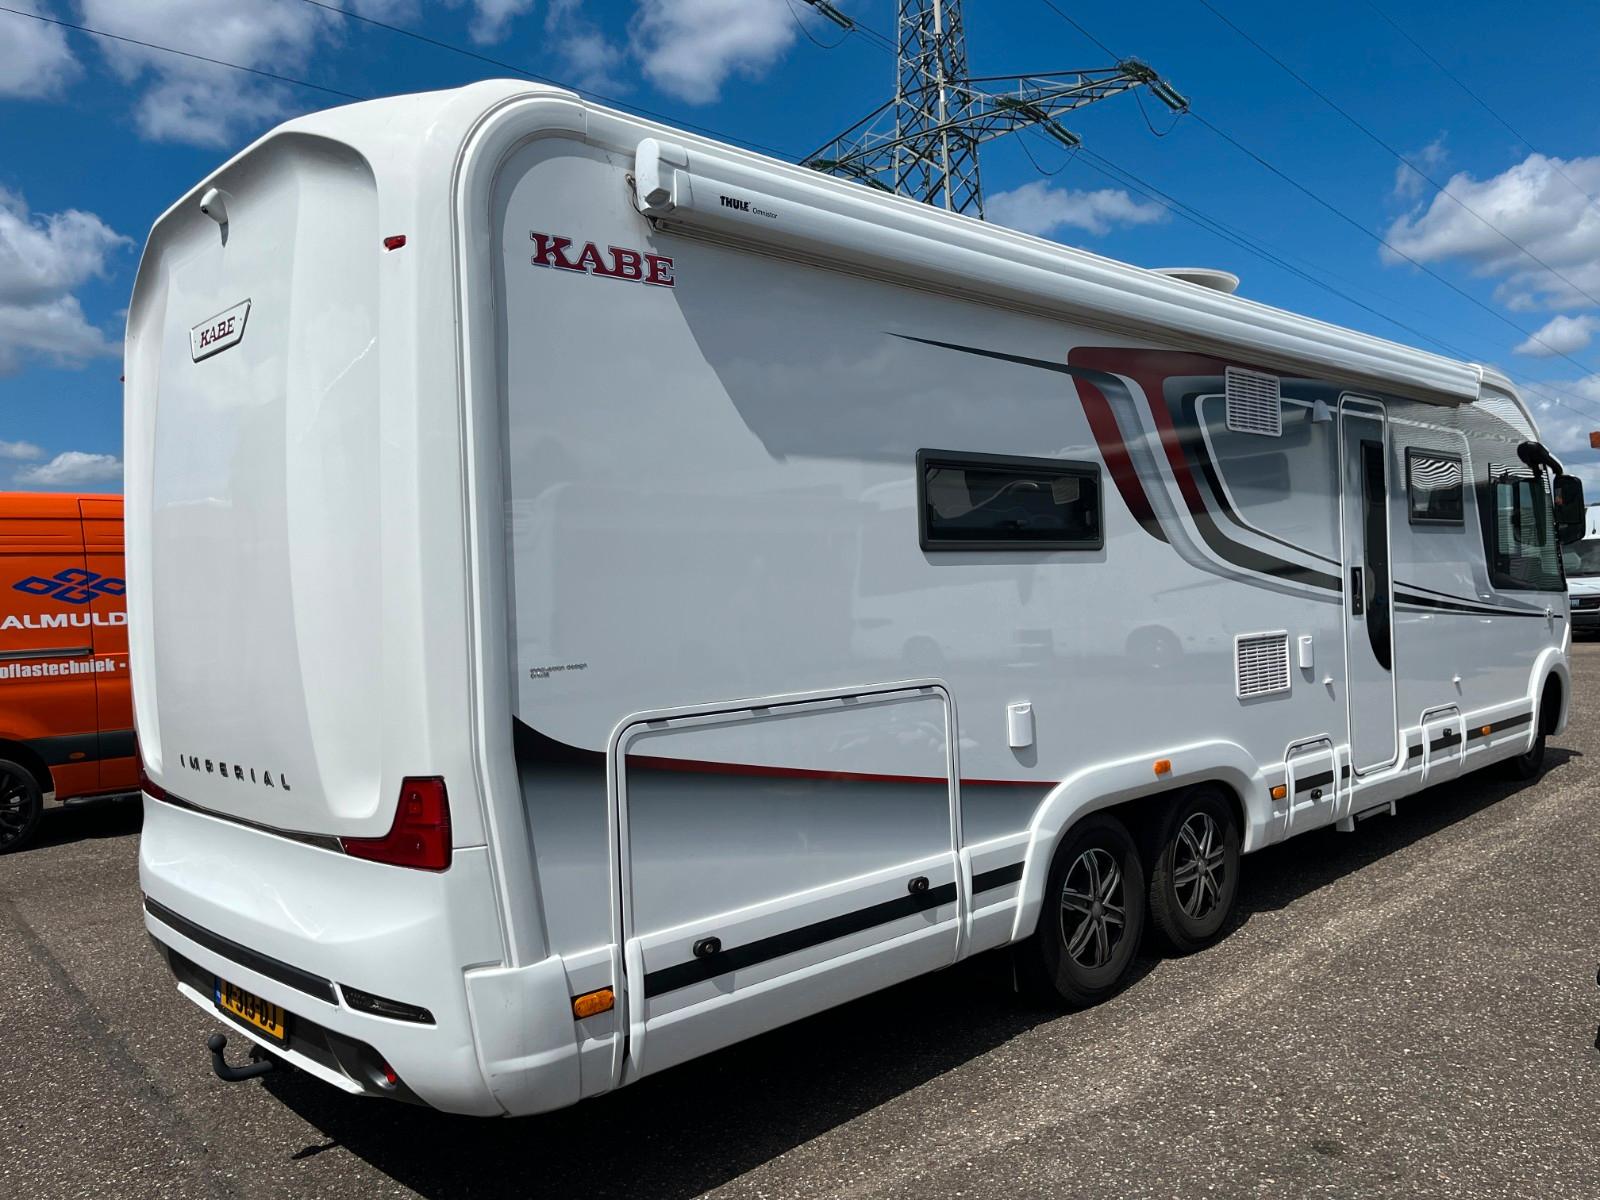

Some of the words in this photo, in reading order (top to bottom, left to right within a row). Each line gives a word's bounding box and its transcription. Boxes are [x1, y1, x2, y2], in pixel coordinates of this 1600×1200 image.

[720, 195, 750, 212] THULE
[530, 231, 675, 287] KABE
[200, 316, 236, 348] KABE
[0, 612, 128, 629] ALMULD
[180, 753, 290, 791] IMPERIAL
